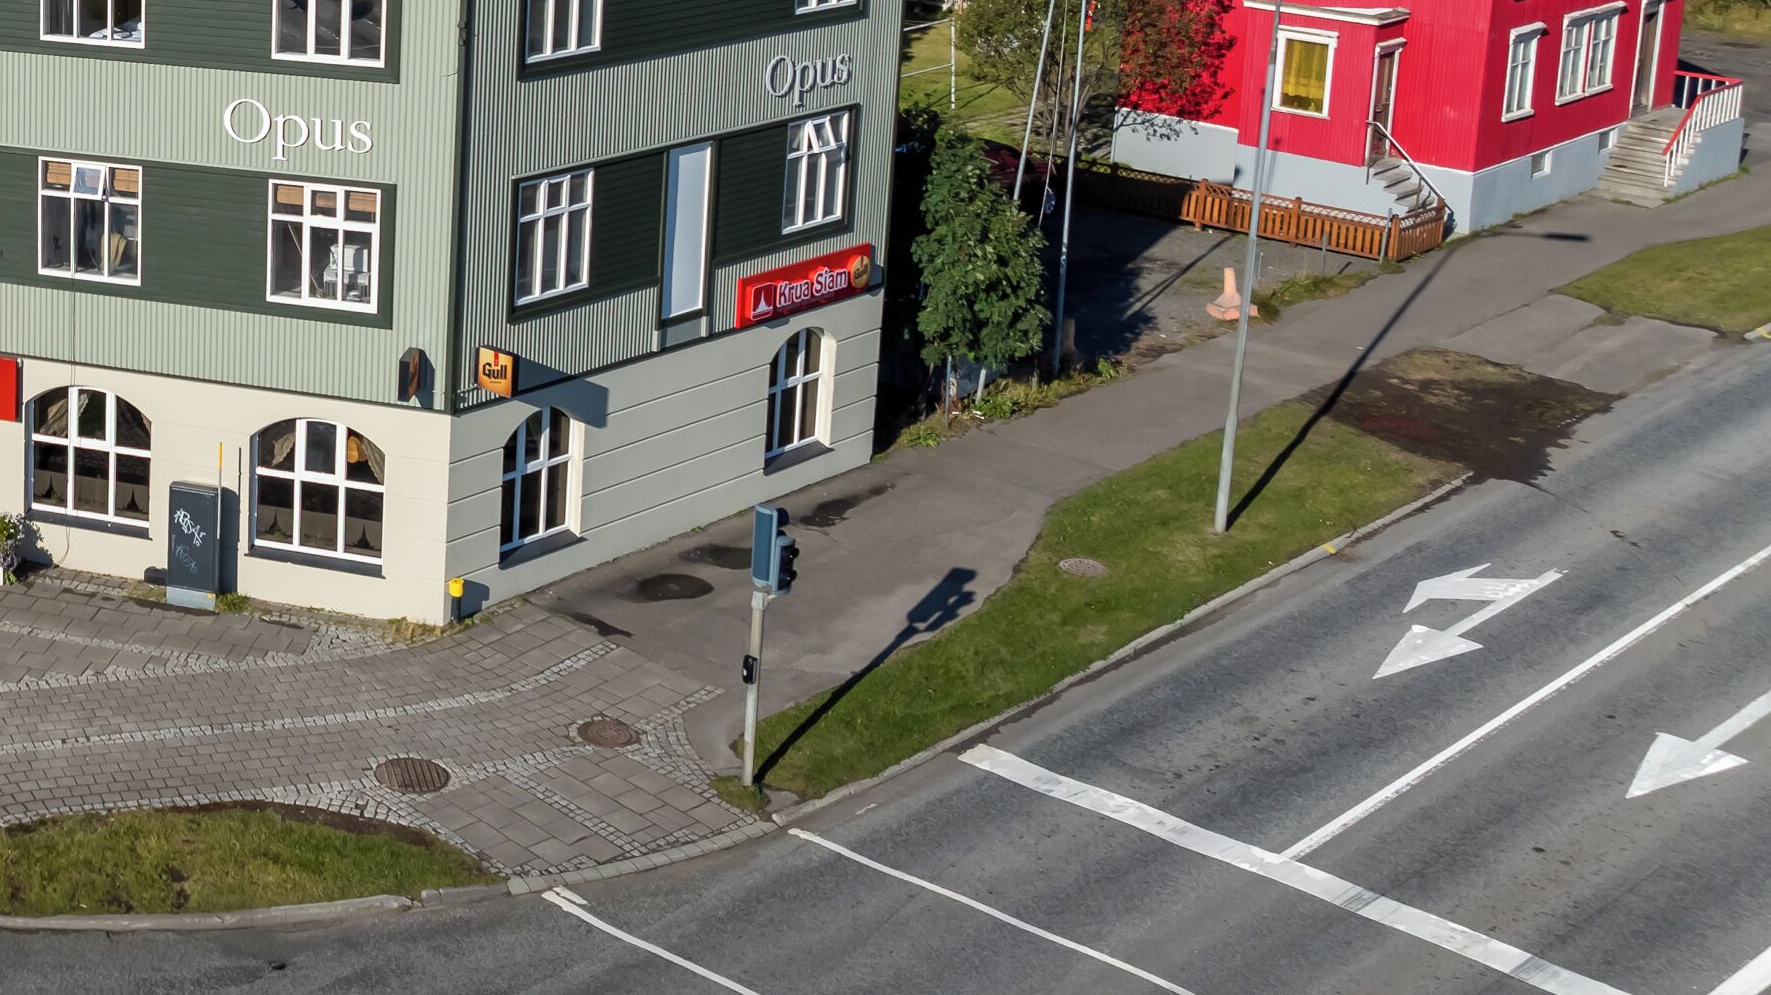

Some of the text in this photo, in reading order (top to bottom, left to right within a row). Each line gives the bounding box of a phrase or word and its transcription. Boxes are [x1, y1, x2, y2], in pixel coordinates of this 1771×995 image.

[765, 53, 851, 106] Opus
[223, 98, 374, 162] Opus
[776, 279, 812, 308] Krua
[812, 267, 849, 297] Siam
[482, 361, 508, 380] Gull
